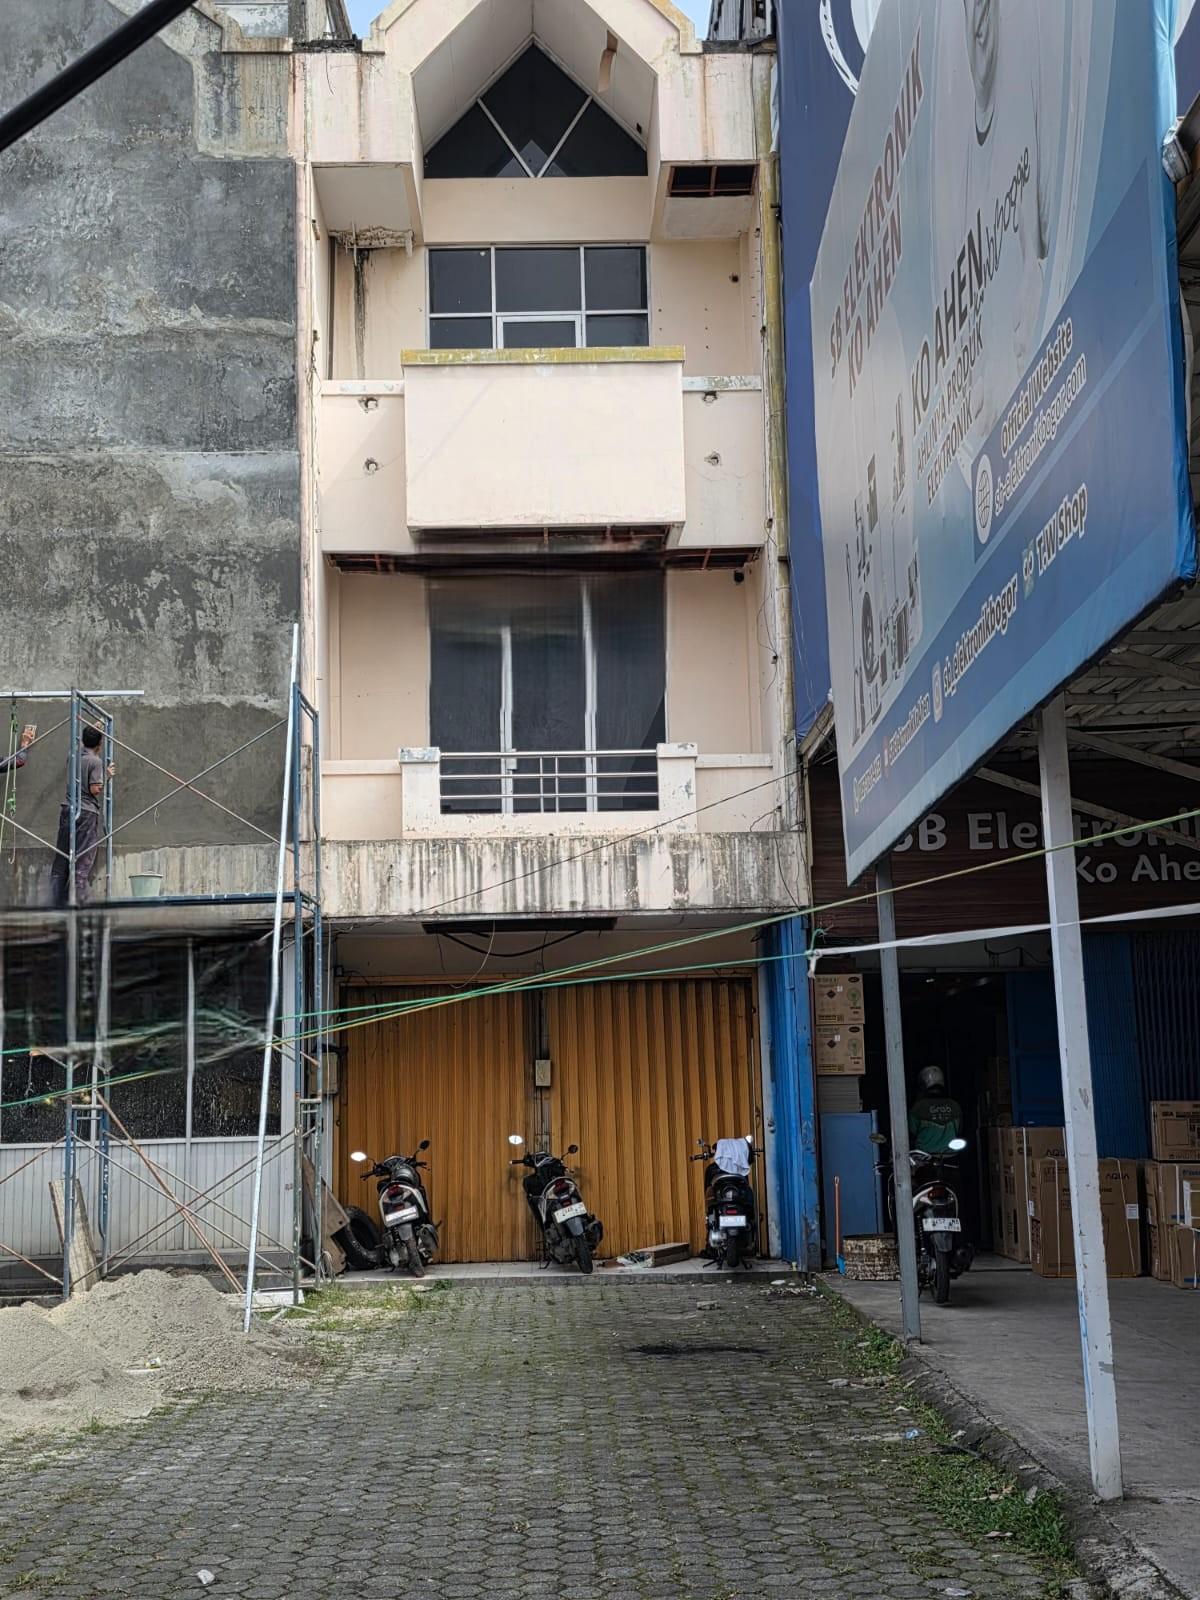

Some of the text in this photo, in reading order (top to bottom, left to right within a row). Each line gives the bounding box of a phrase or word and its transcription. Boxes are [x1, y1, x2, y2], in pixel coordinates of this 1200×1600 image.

[831, 26, 923, 379] SB ELEKTRONIK
[848, 192, 902, 399] KO AHEN
[911, 208, 983, 436] KO AHEN
[917, 314, 983, 480] AHLINYA PRODUK
[927, 390, 973, 506] ELEKTRONIK
[1002, 318, 1073, 455] Official Website
[967, 806, 1200, 850] Eletroni
[1076, 855, 1117, 883] Ko
[1105, 1172, 1130, 1180] AQUA
